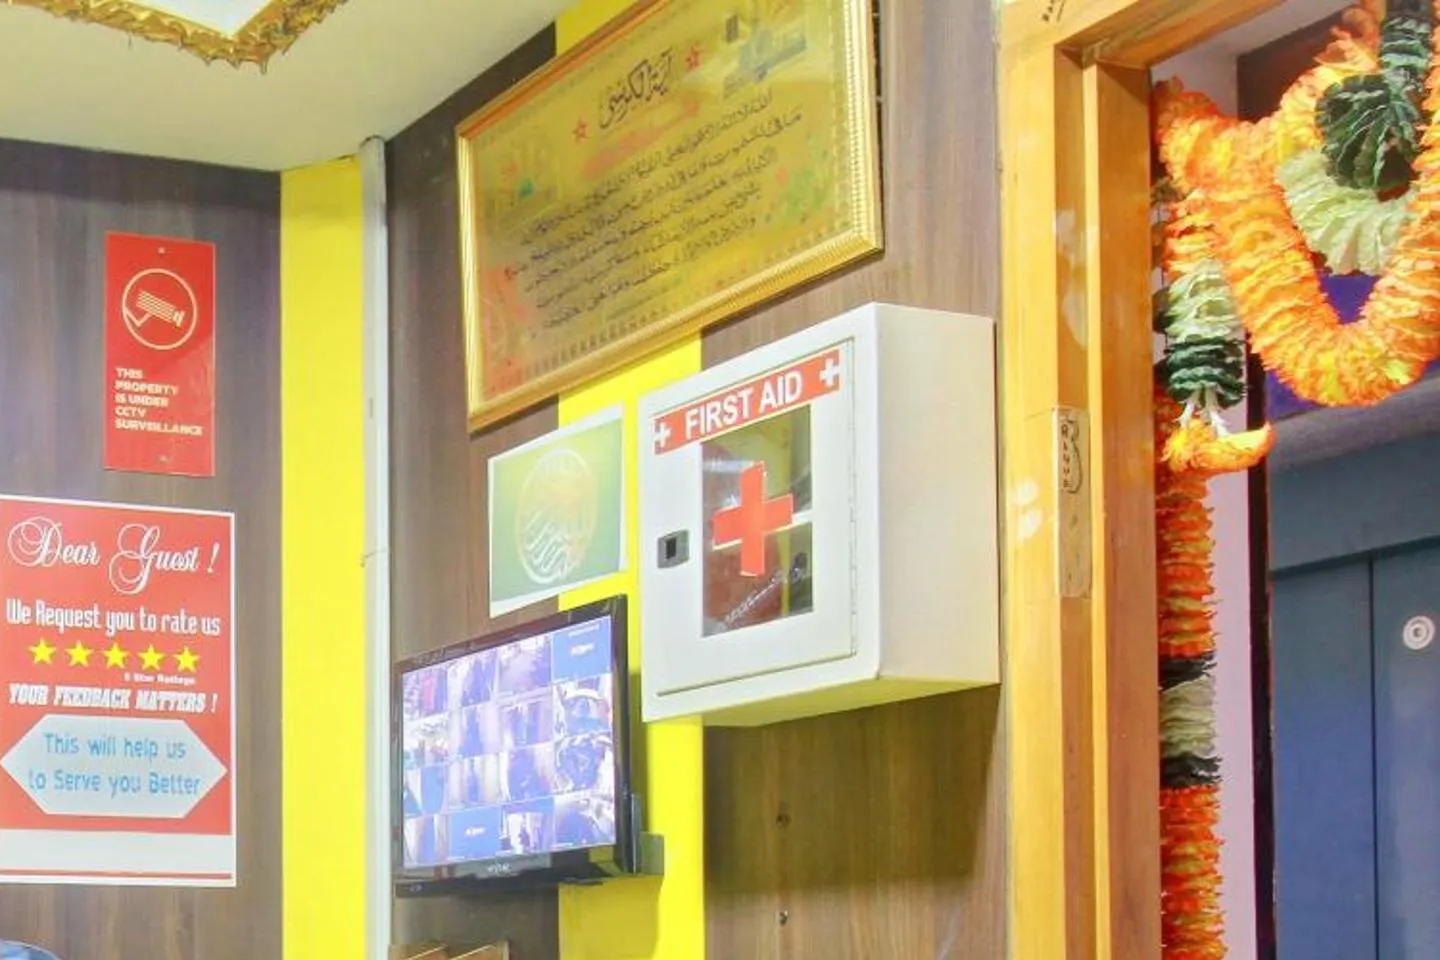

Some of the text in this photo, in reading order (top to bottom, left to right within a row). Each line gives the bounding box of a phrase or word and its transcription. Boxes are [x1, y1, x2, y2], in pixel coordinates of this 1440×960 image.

[116, 367, 143, 379] THIS
[115, 406, 147, 417] CCTV
[685, 369, 803, 440] FIRST AID
[7, 516, 101, 567] Dear
[109, 523, 200, 595] Guest
[6, 598, 221, 636] We Request you to rate us
[9, 683, 48, 705] YOUR
[53, 685, 132, 710] FEEDBACK
[135, 690, 207, 713] MATTERS
[43, 732, 187, 764] This will help us
[28, 769, 203, 799] to Serve you Better
